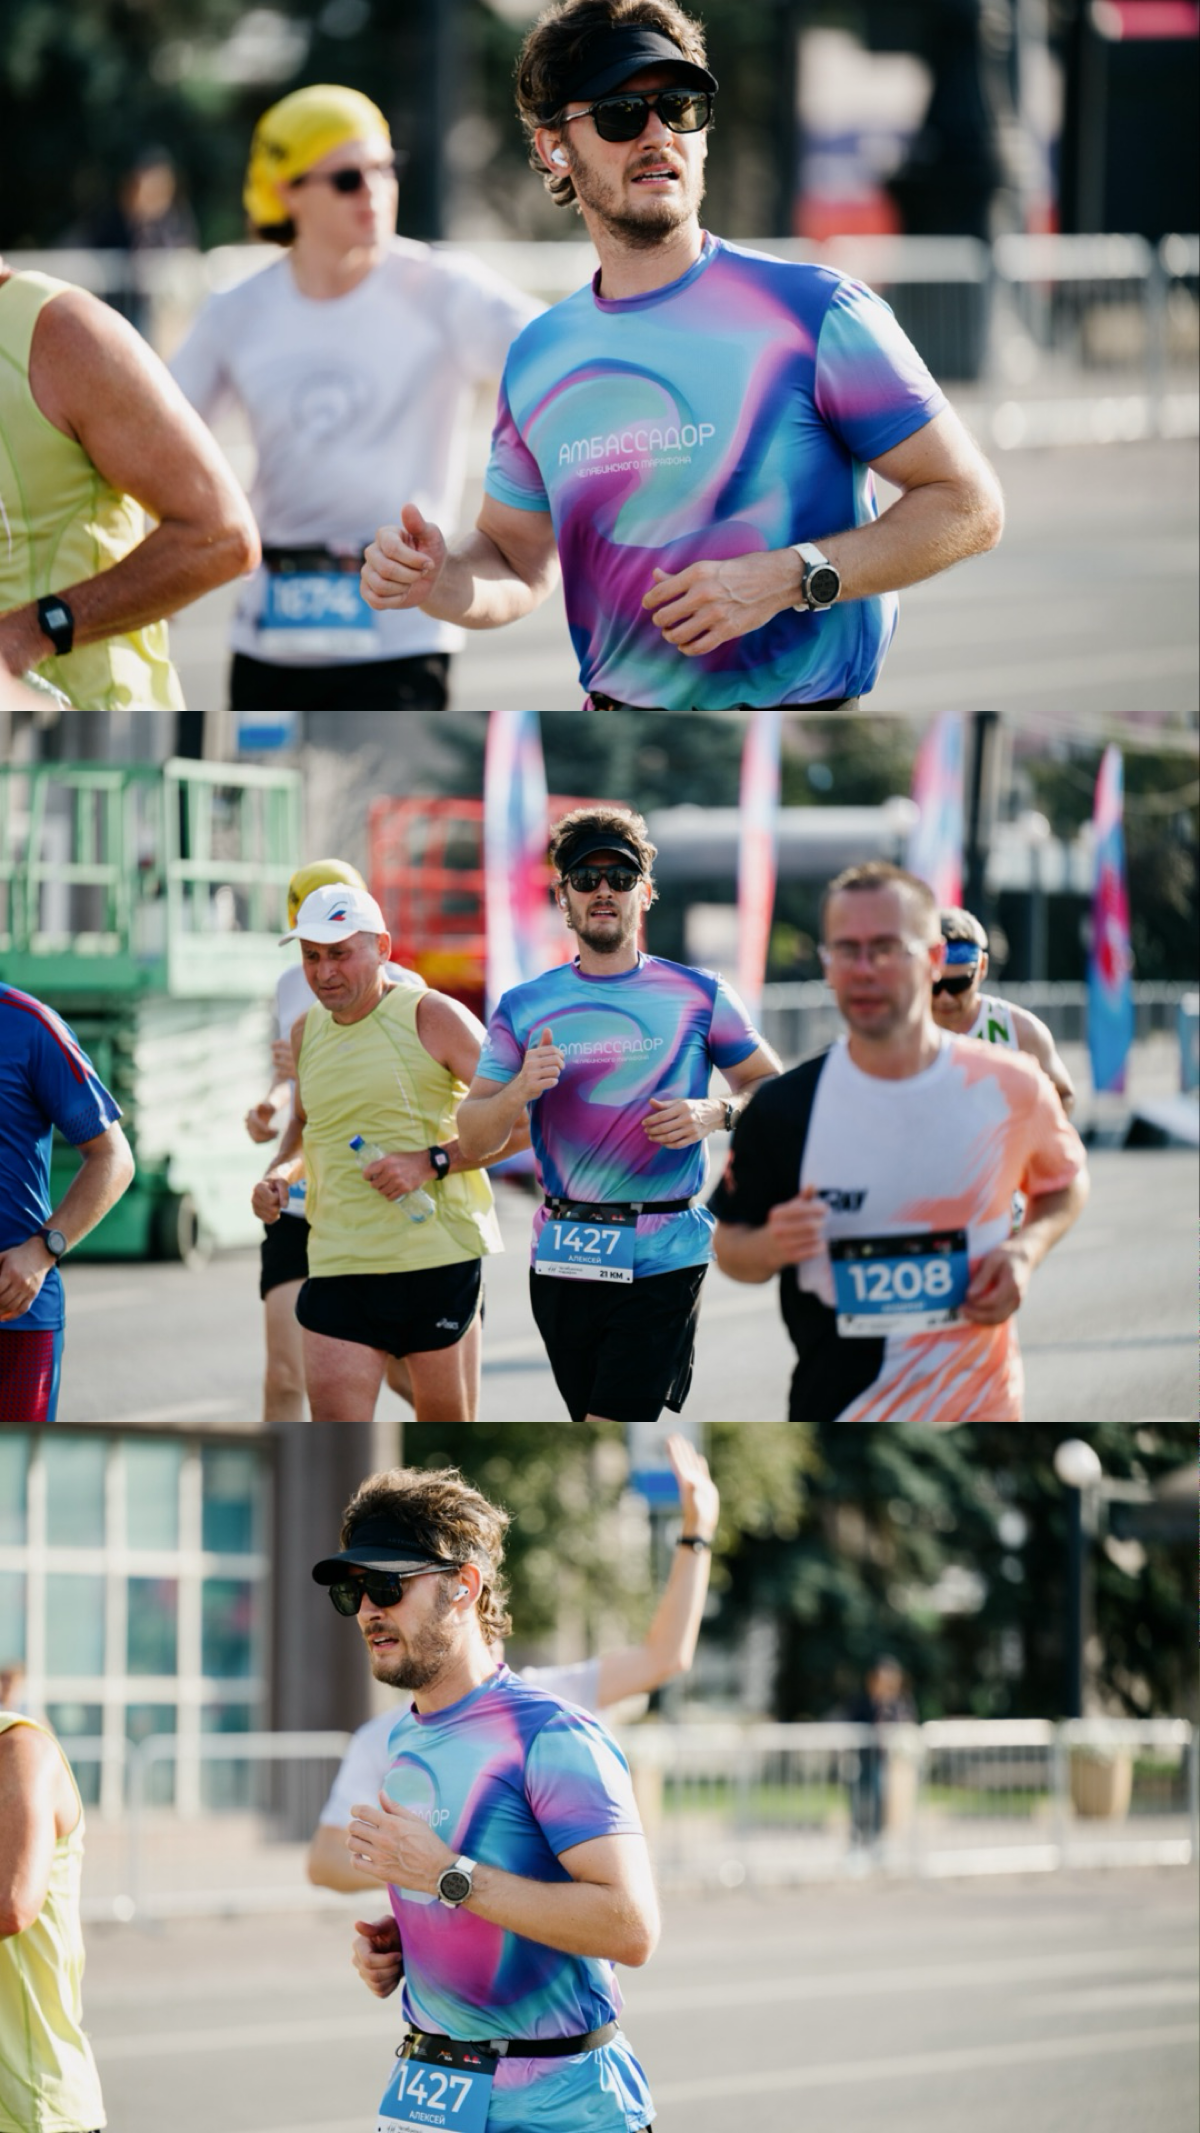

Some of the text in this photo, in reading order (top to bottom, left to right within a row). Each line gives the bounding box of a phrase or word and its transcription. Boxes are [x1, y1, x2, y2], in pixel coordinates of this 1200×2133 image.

[559, 423, 716, 466] АМБАССАДОР
[559, 1038, 664, 1055] АМБАССАДОР
[553, 1224, 621, 1255] 1427
[568, 1255, 602, 1264] АЛЕКСЕЙ
[599, 1270, 608, 1278] 21
[848, 1259, 953, 1302] 1208
[397, 2064, 473, 2113] 1427
[409, 2110, 446, 2125] АЛЕКСЕЙ
